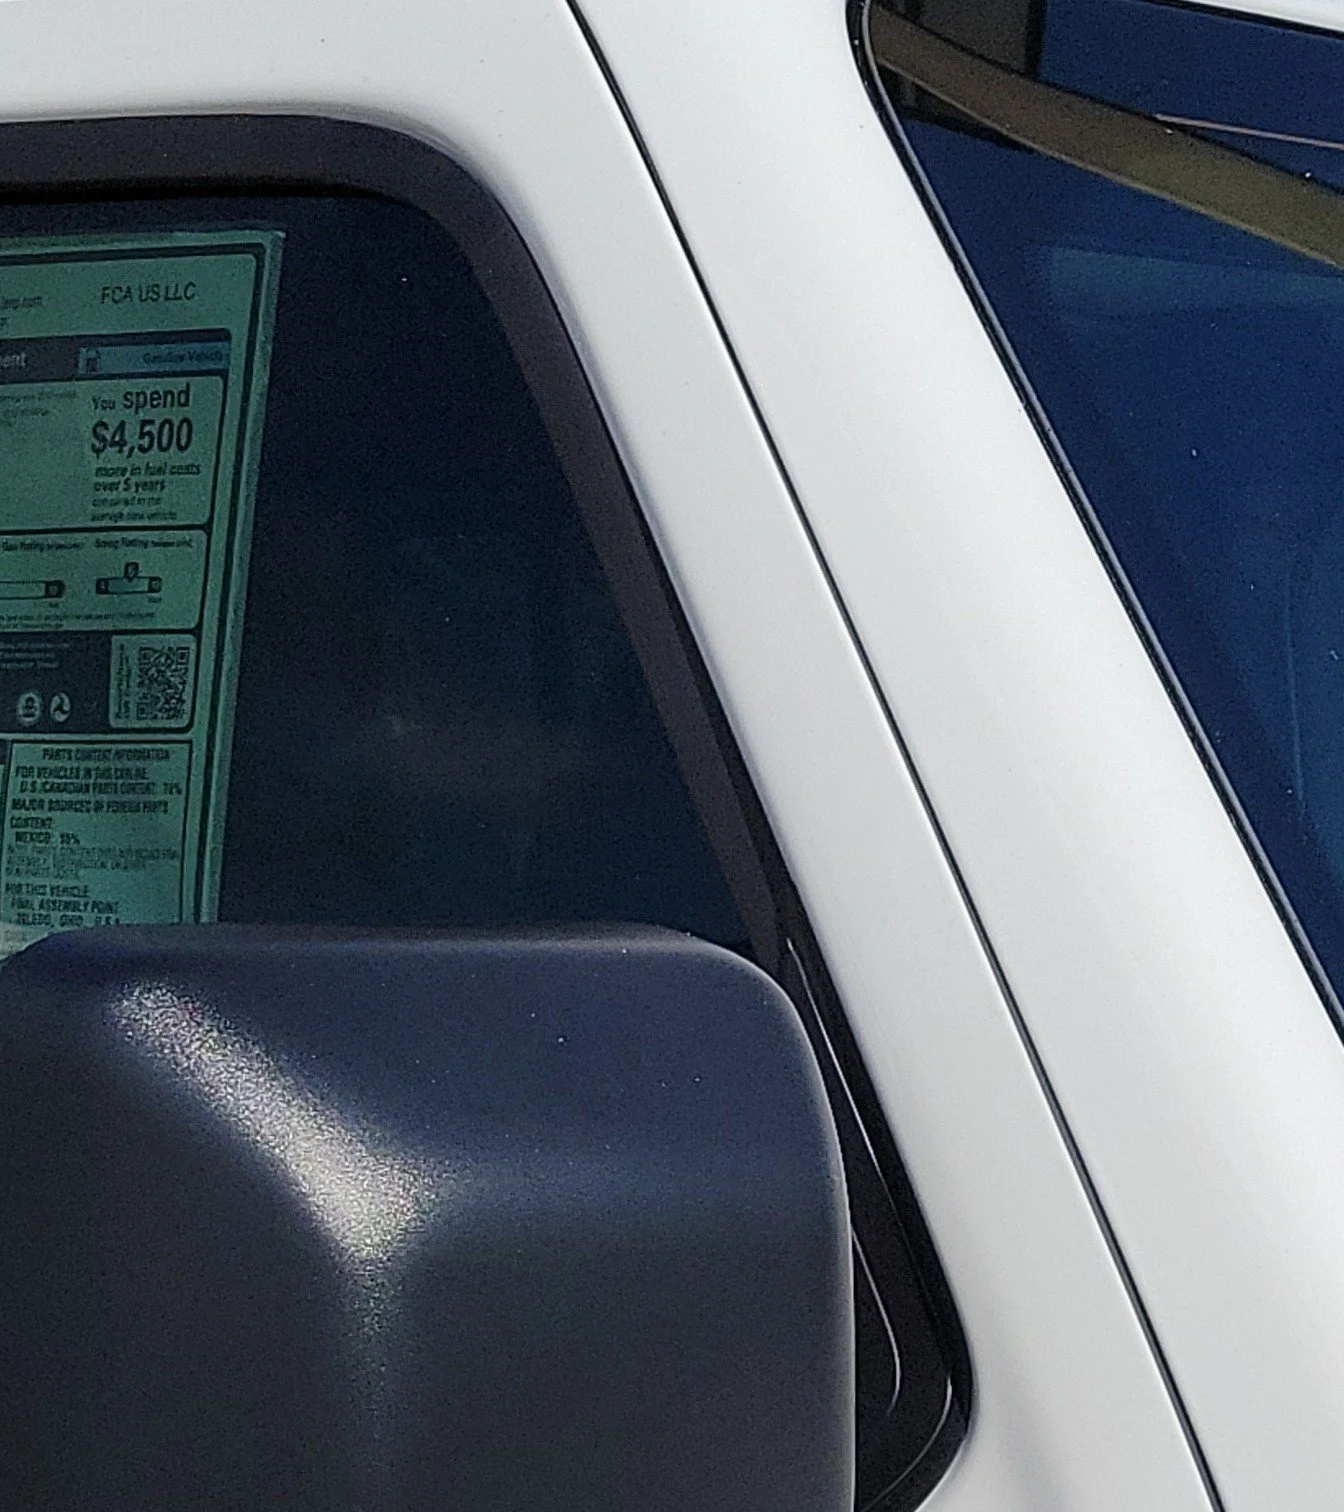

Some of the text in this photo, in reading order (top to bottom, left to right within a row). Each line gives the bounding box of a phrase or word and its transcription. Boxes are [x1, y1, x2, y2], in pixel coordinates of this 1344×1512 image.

[100, 280, 197, 305] FCA US LLC
[91, 395, 116, 411] You
[122, 382, 191, 415] spend
[90, 417, 194, 460] $4,500
[94, 465, 128, 478] more
[144, 461, 167, 476] fuel
[93, 477, 166, 494] over 5 years
